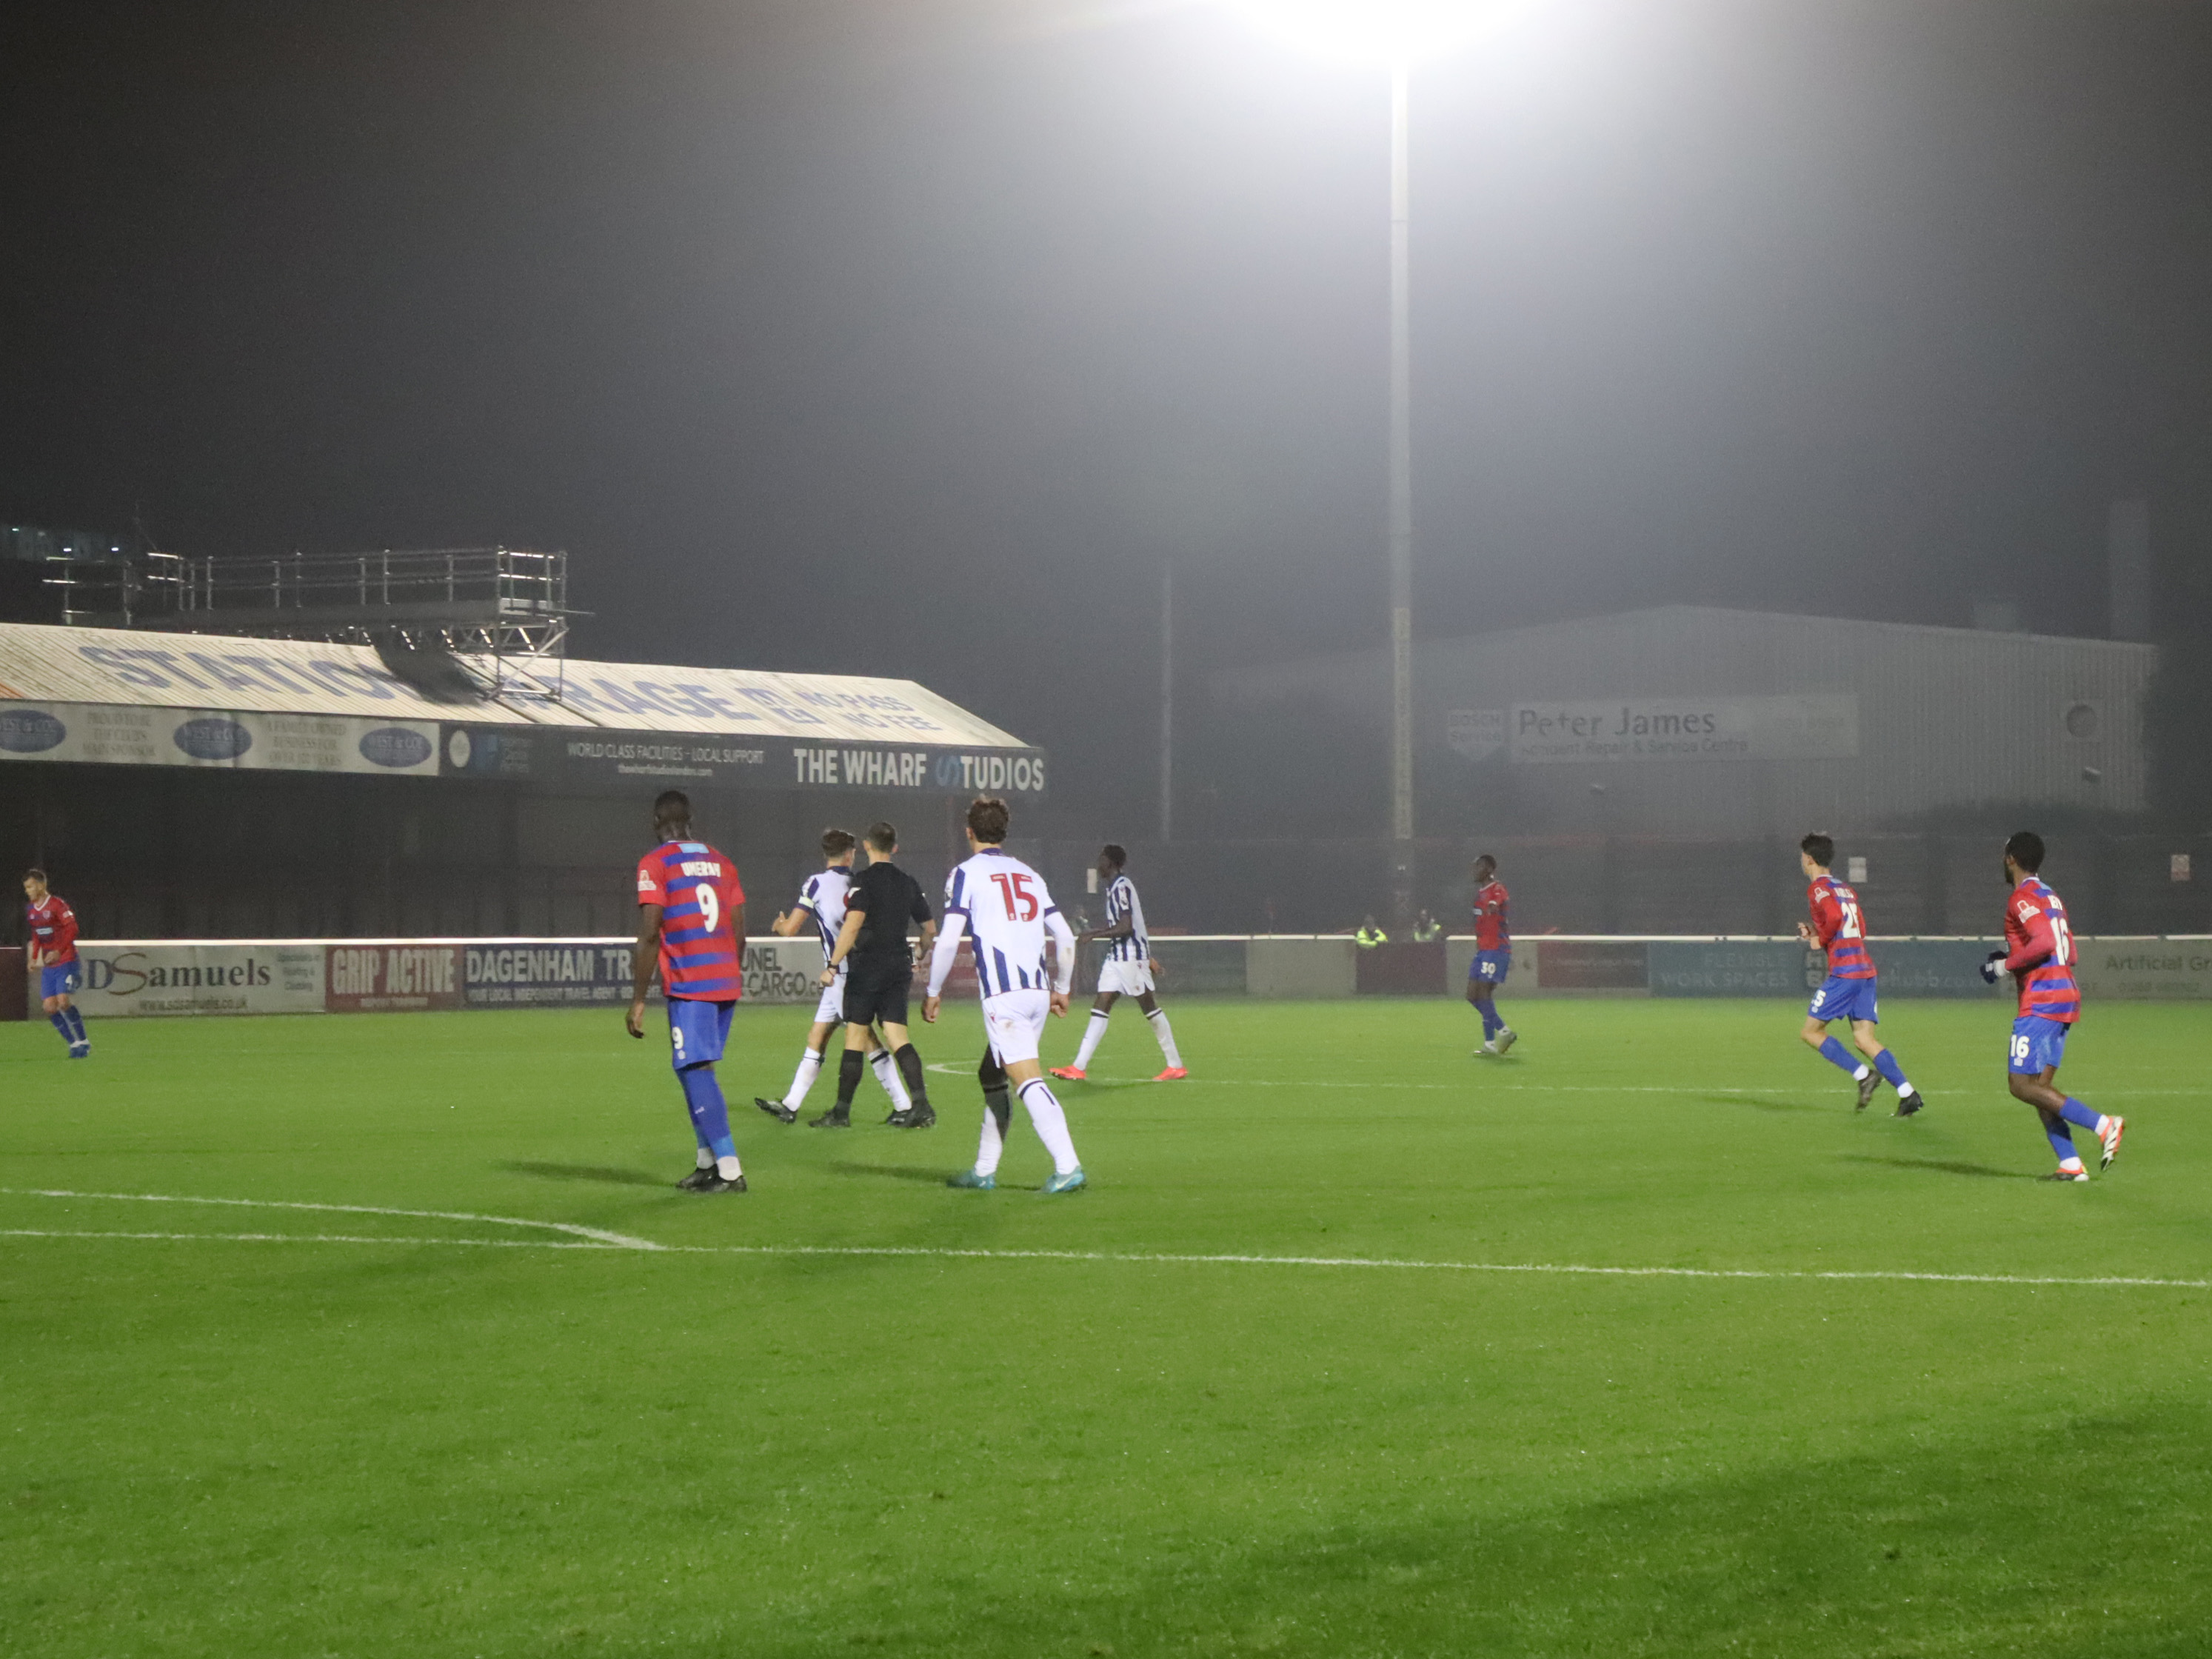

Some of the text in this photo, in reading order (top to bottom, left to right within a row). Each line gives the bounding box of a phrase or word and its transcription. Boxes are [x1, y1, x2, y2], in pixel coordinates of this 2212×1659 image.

[793, 690, 915, 712] NO PASS
[840, 712, 943, 730] NO FEE
[1518, 707, 1716, 738] Peter James
[567, 741, 604, 757] WORLD
[605, 744, 635, 758] CLASS
[638, 745, 683, 761] FACILITIES
[692, 748, 722, 763] LOCAL
[723, 750, 764, 764] SUPPORT
[793, 748, 1045, 792] THE WHARF STUDIOS
[695, 882, 720, 933] 9
[989, 872, 1038, 922] 15
[2050, 917, 2070, 966] 16
[333, 949, 455, 994] GRIP ACTIVE
[466, 949, 635, 982] DAGENHAM TR
[741, 947, 782, 972] UNEL
[1480, 961, 1496, 975] 30
[2105, 954, 2212, 972] Artificial Gr
[1660, 971, 1790, 988] WORK SPACES
[671, 1026, 684, 1050] 9
[2010, 1035, 2030, 1059] 16
